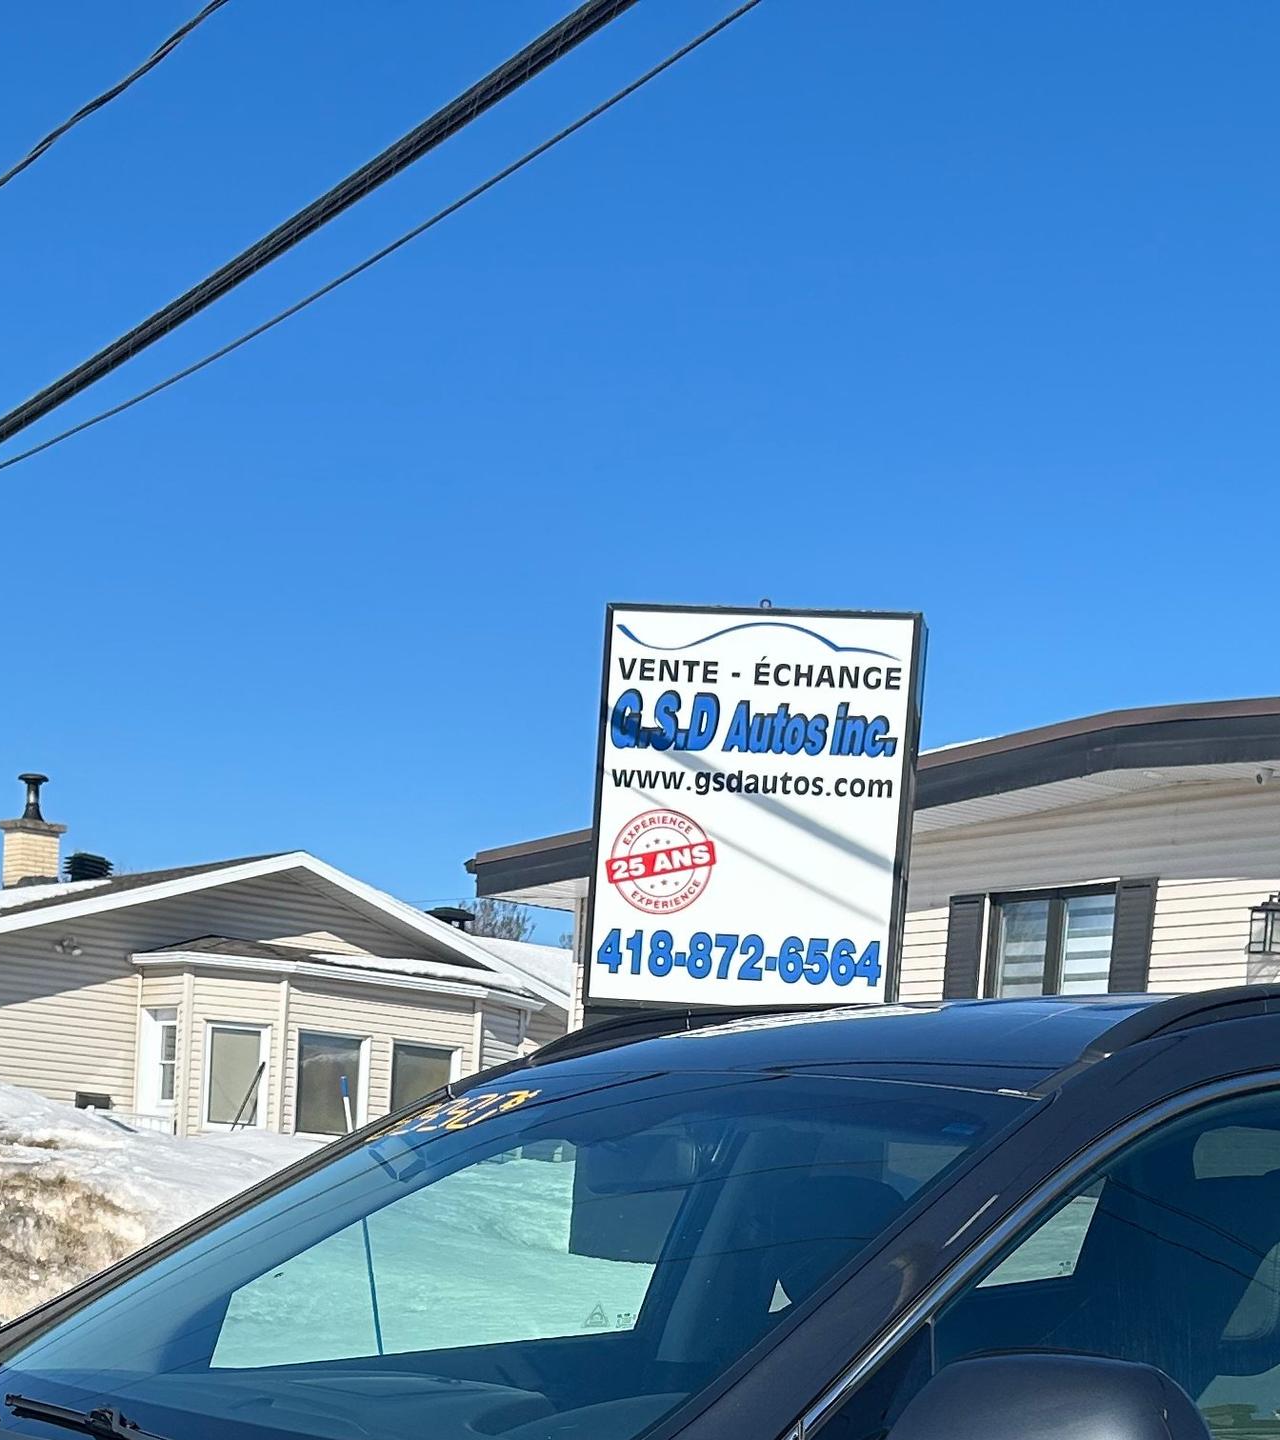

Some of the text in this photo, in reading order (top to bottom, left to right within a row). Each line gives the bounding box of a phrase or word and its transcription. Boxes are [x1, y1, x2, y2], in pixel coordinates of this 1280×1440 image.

[618, 657, 719, 684] VENTE
[753, 656, 903, 691] ÉCHANGE
[610, 688, 720, 751] G.S.D
[722, 700, 829, 756] Autos
[611, 768, 894, 799] www.gsdautos.com
[611, 845, 711, 879] 25 ANS
[596, 928, 882, 987] 418-872-6564
